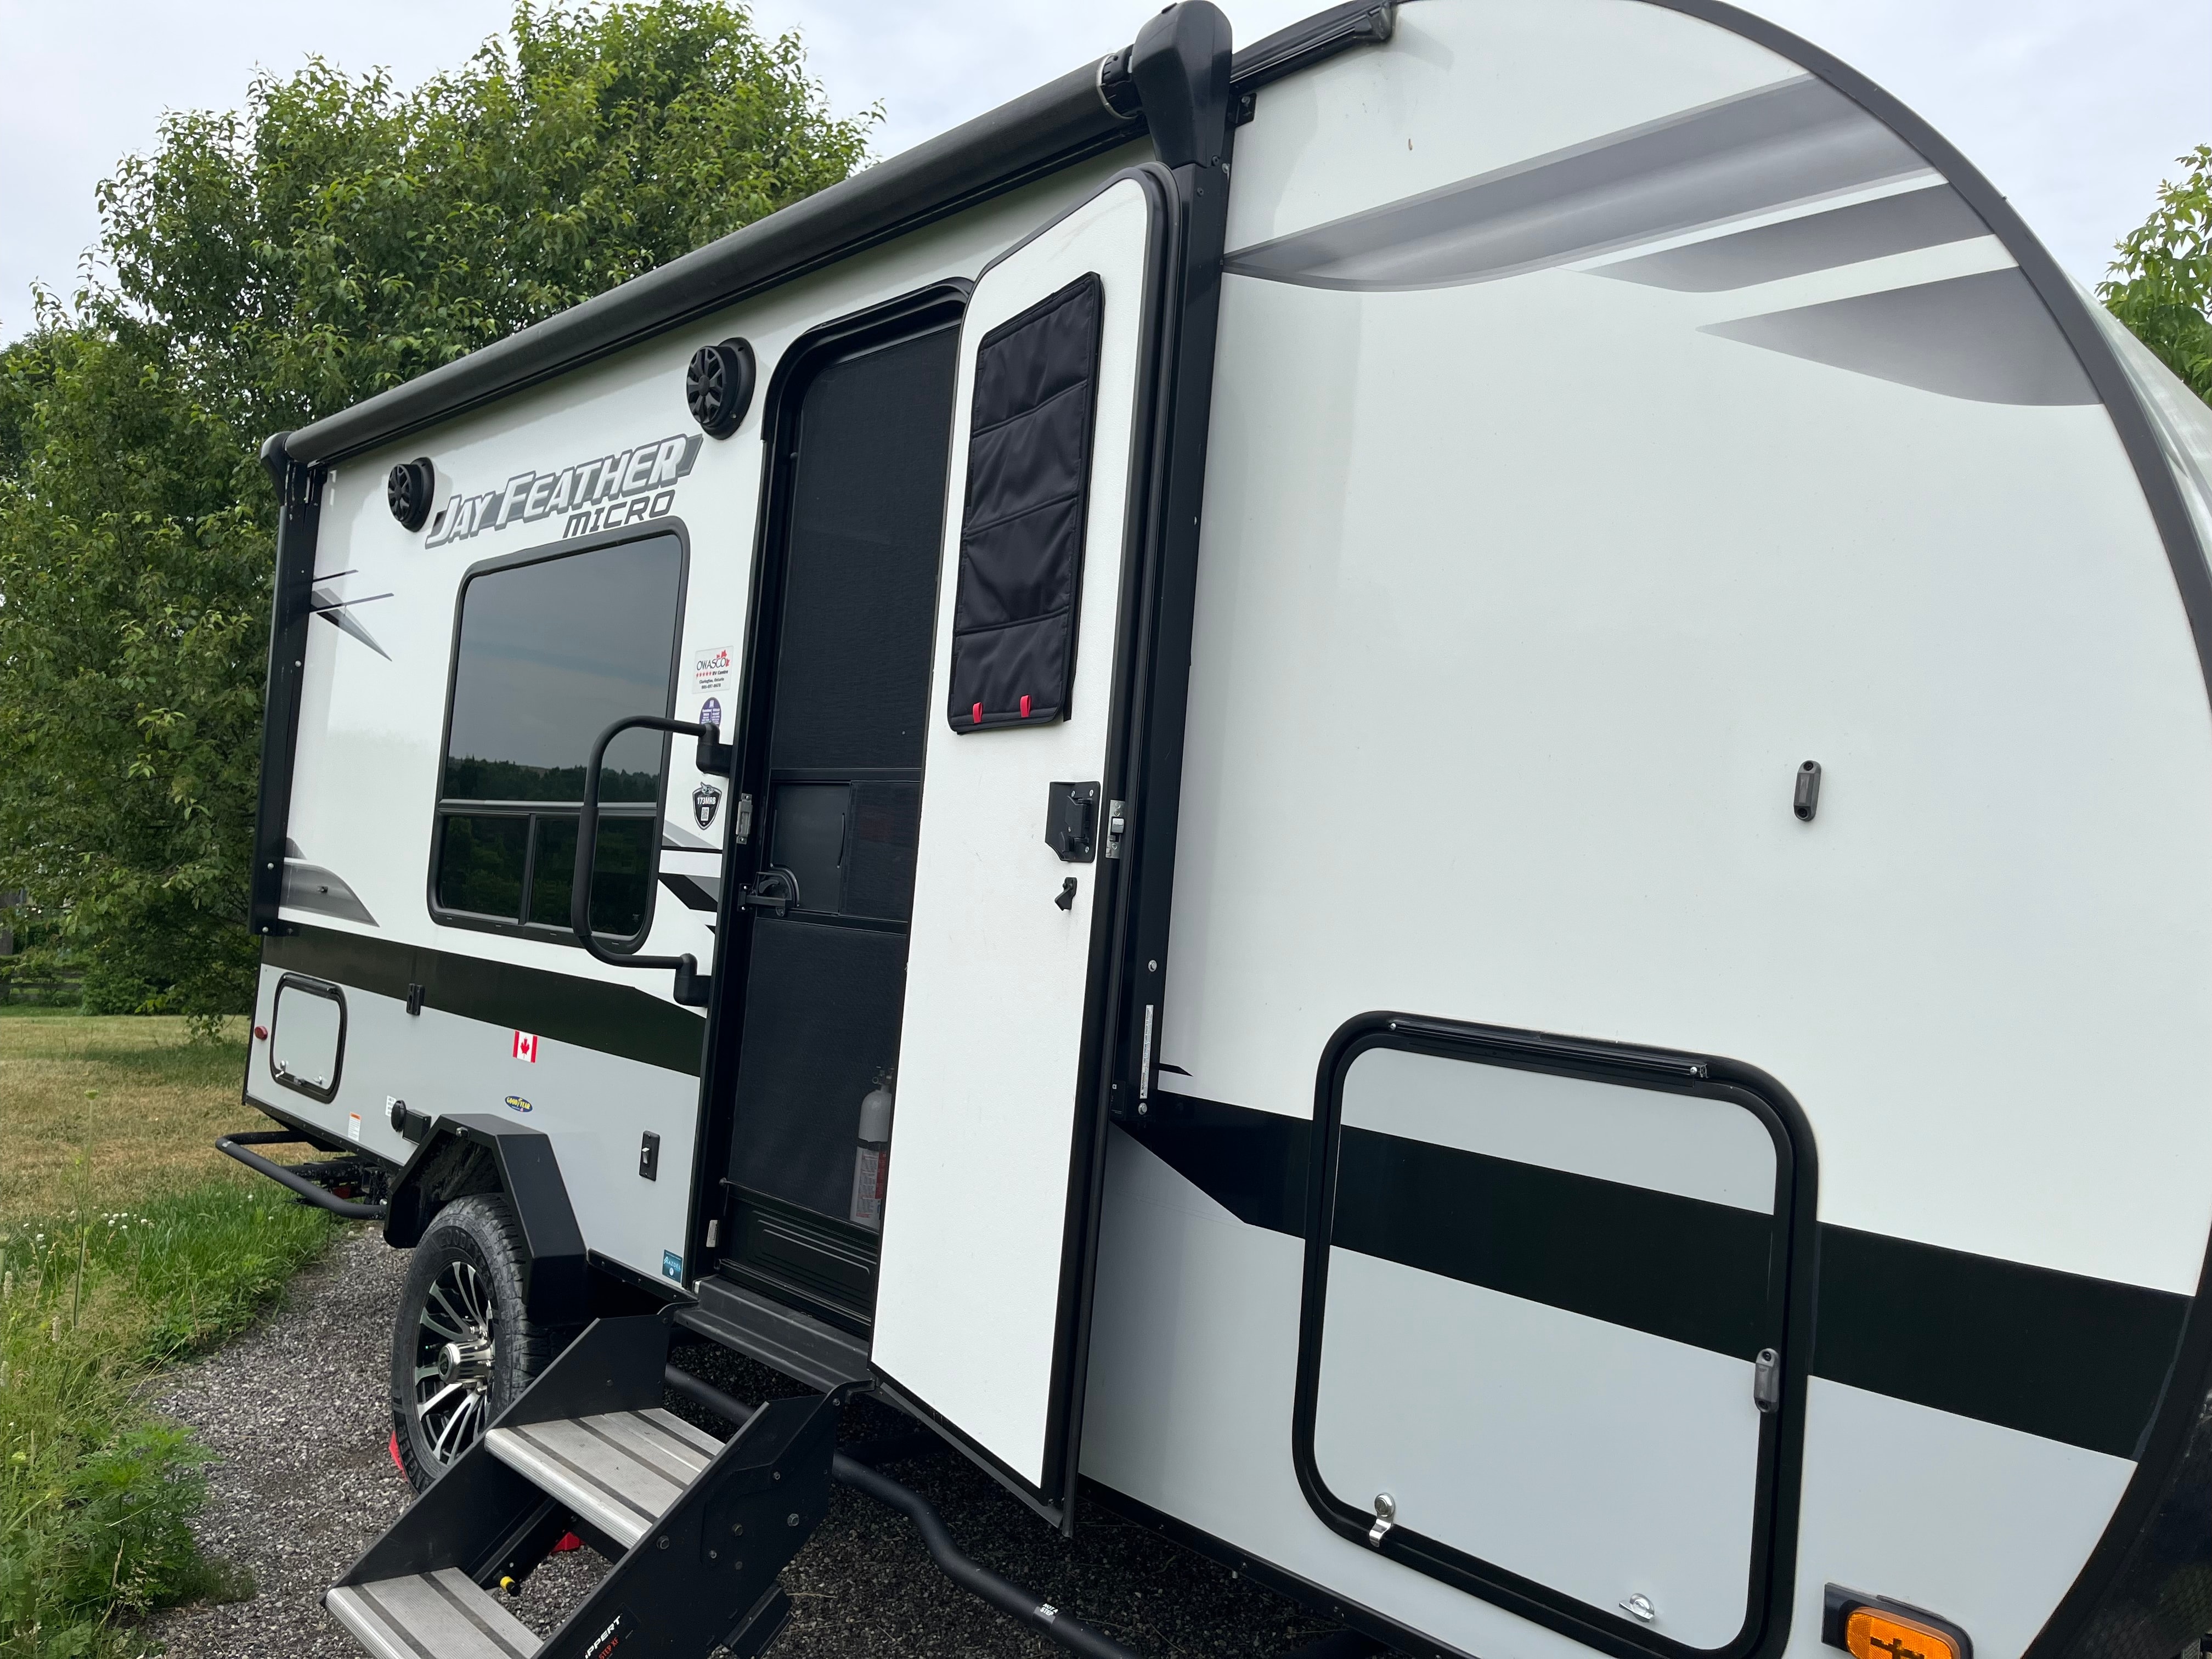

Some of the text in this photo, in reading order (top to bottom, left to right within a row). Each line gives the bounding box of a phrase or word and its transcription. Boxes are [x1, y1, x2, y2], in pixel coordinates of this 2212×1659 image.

[425, 433, 688, 549] JAY FEATHER
[563, 489, 675, 538] MICRO
[697, 657, 726, 670] OWASCO
[697, 797, 716, 805] 173MRB
[506, 1097, 531, 1110] GOODYEAR
[398, 1424, 432, 1494] ANGLER
[1040, 1607, 1054, 1616] STEP
[585, 1615, 621, 1659] IPPERT
